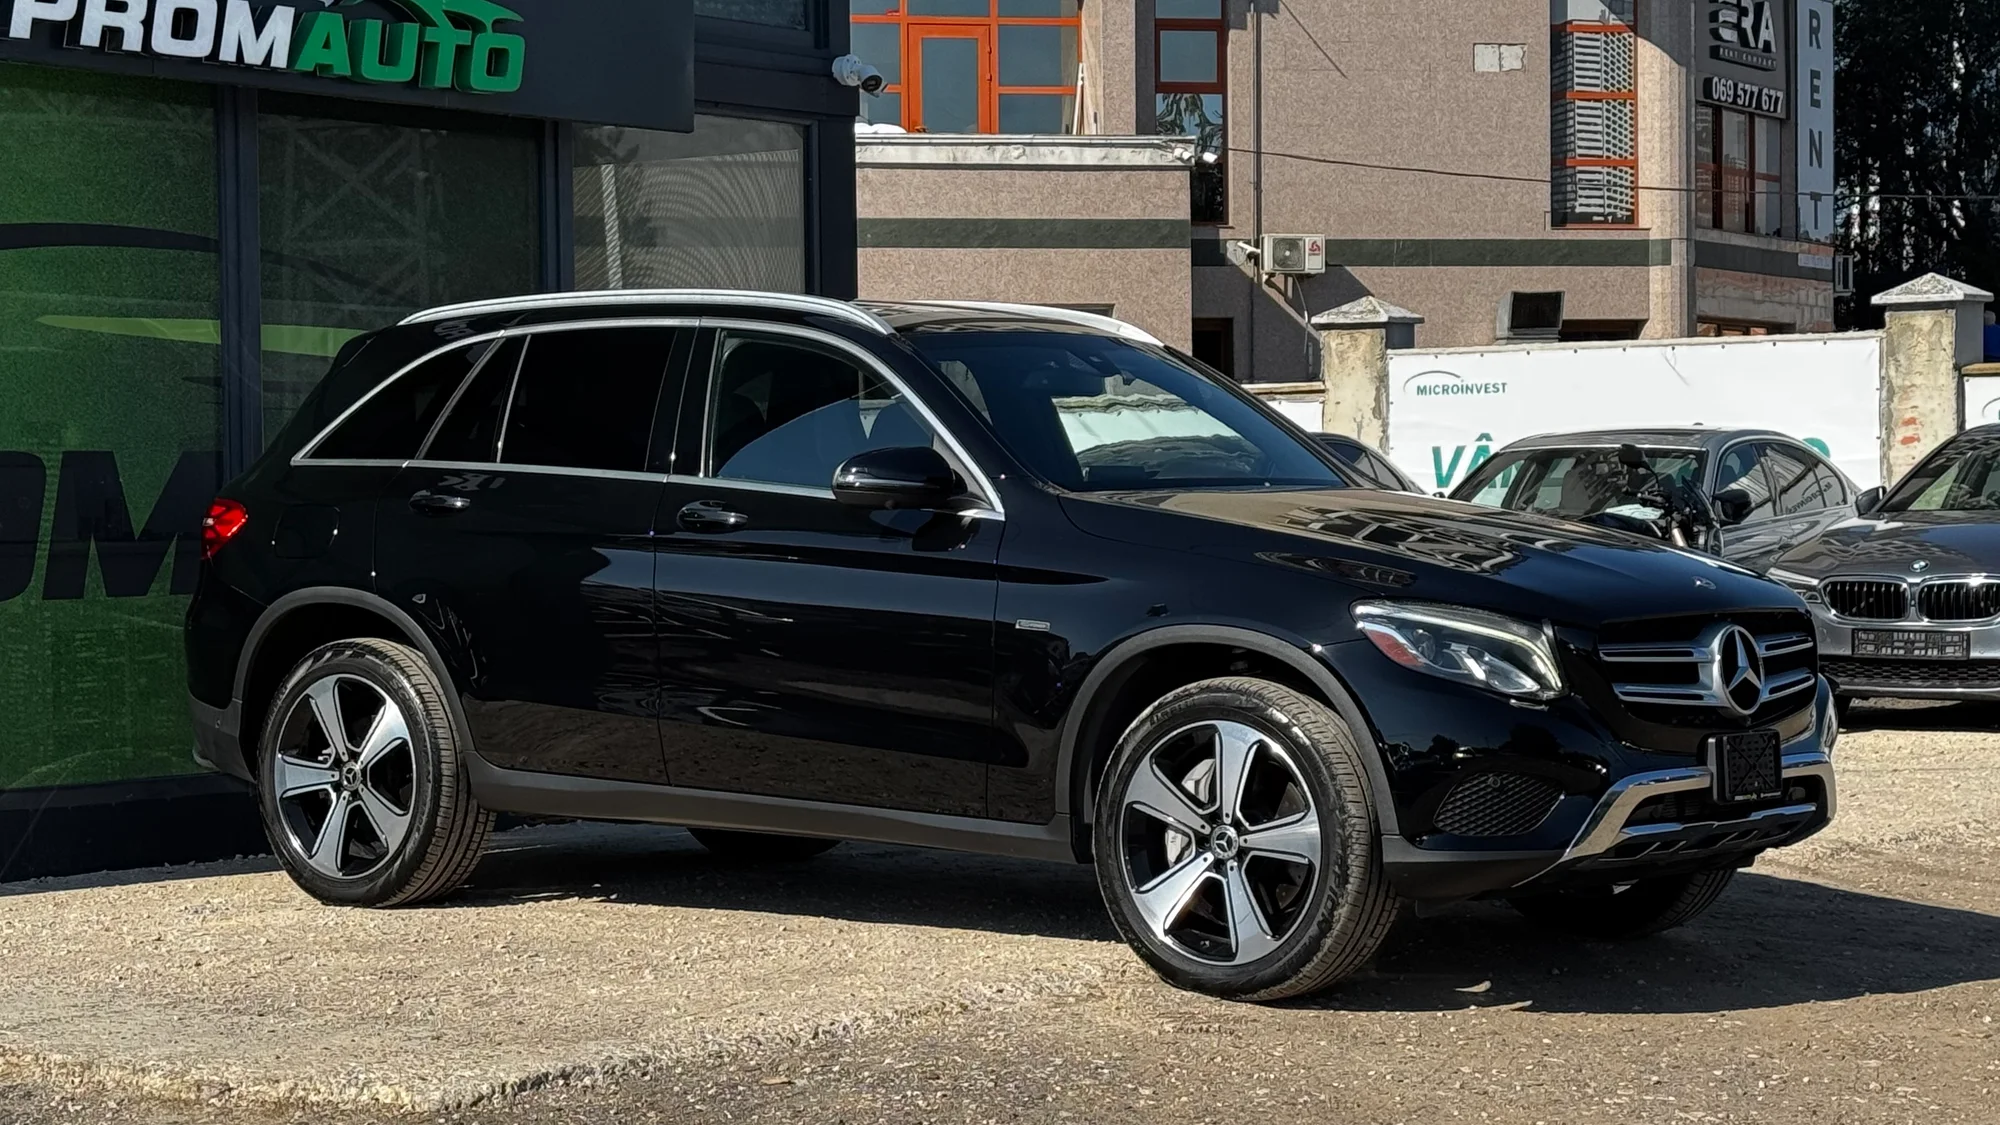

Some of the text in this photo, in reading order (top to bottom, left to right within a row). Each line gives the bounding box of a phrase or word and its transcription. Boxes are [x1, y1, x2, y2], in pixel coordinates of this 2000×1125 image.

[1712, 76, 1784, 114] 069 577 677
[1808, 8, 1823, 230] RENT
